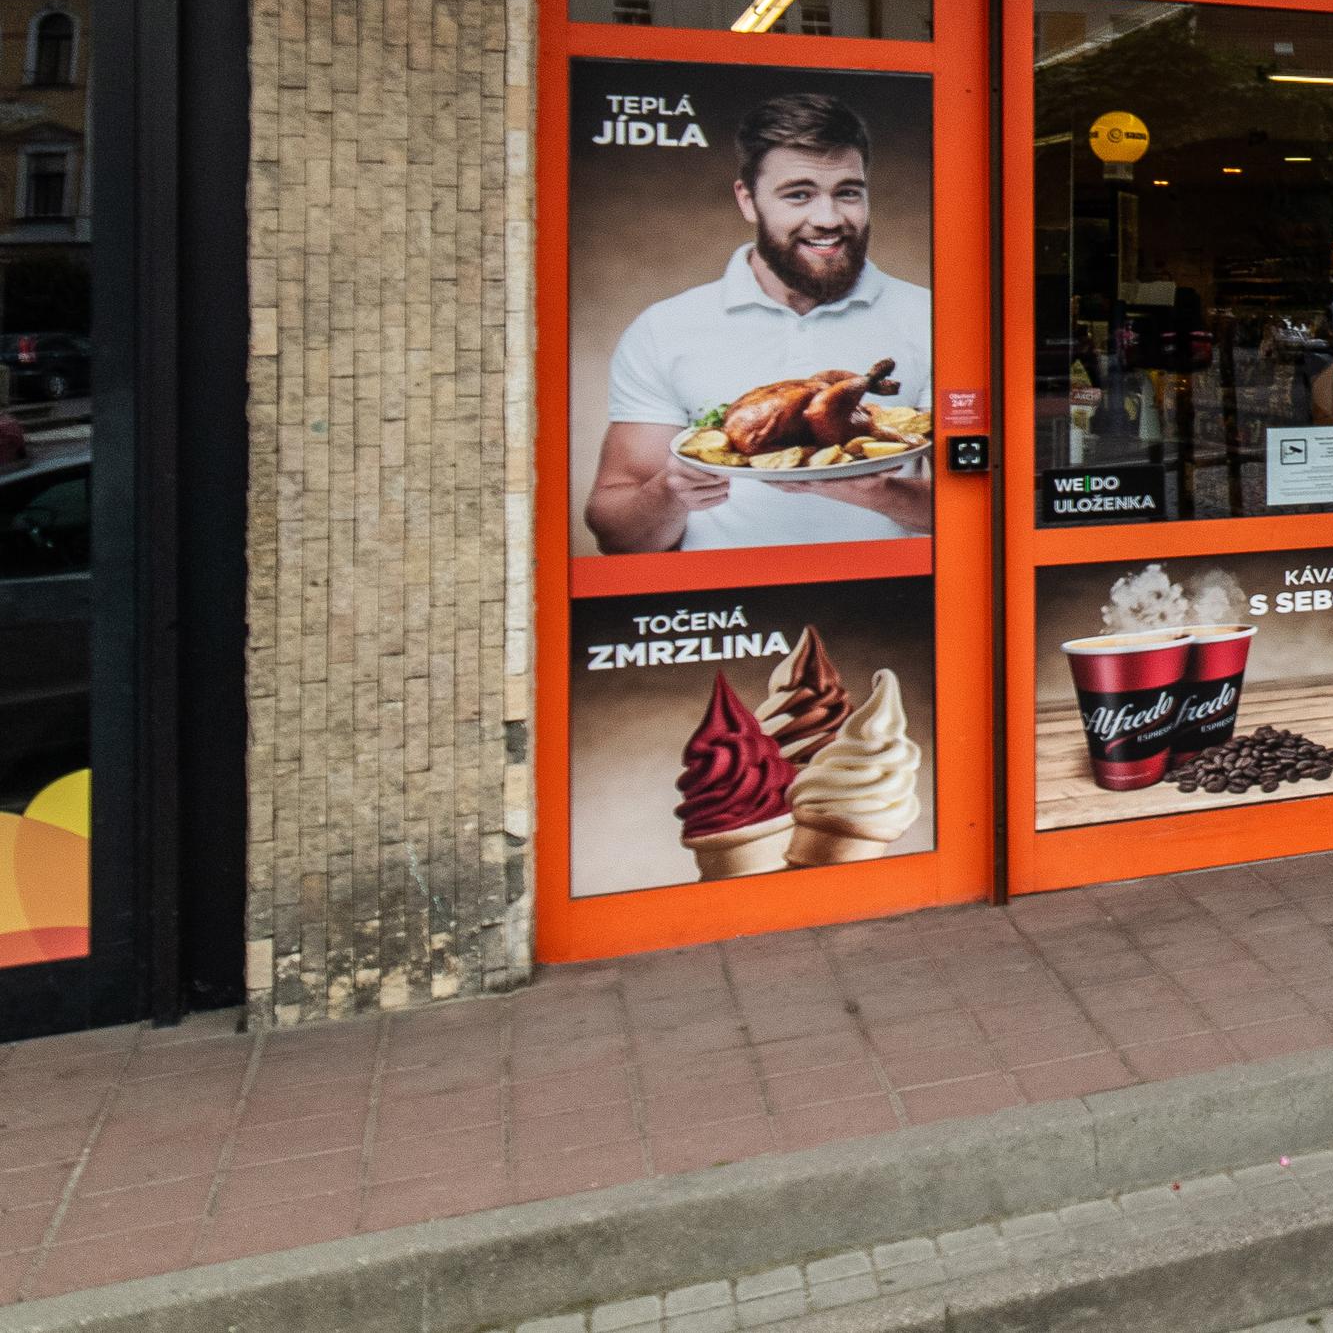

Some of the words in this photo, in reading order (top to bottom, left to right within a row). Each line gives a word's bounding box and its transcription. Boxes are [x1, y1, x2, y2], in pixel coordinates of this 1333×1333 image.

[607, 94, 696, 116] TEPLÁ
[592, 115, 709, 148] JÍDLA
[1053, 494, 1156, 514] ULOŽENKA
[1249, 594, 1269, 616] S
[633, 606, 748, 635] TOČENÁ
[588, 631, 791, 671] ZMRZLINA
[1087, 691, 1174, 742] Alfredo
